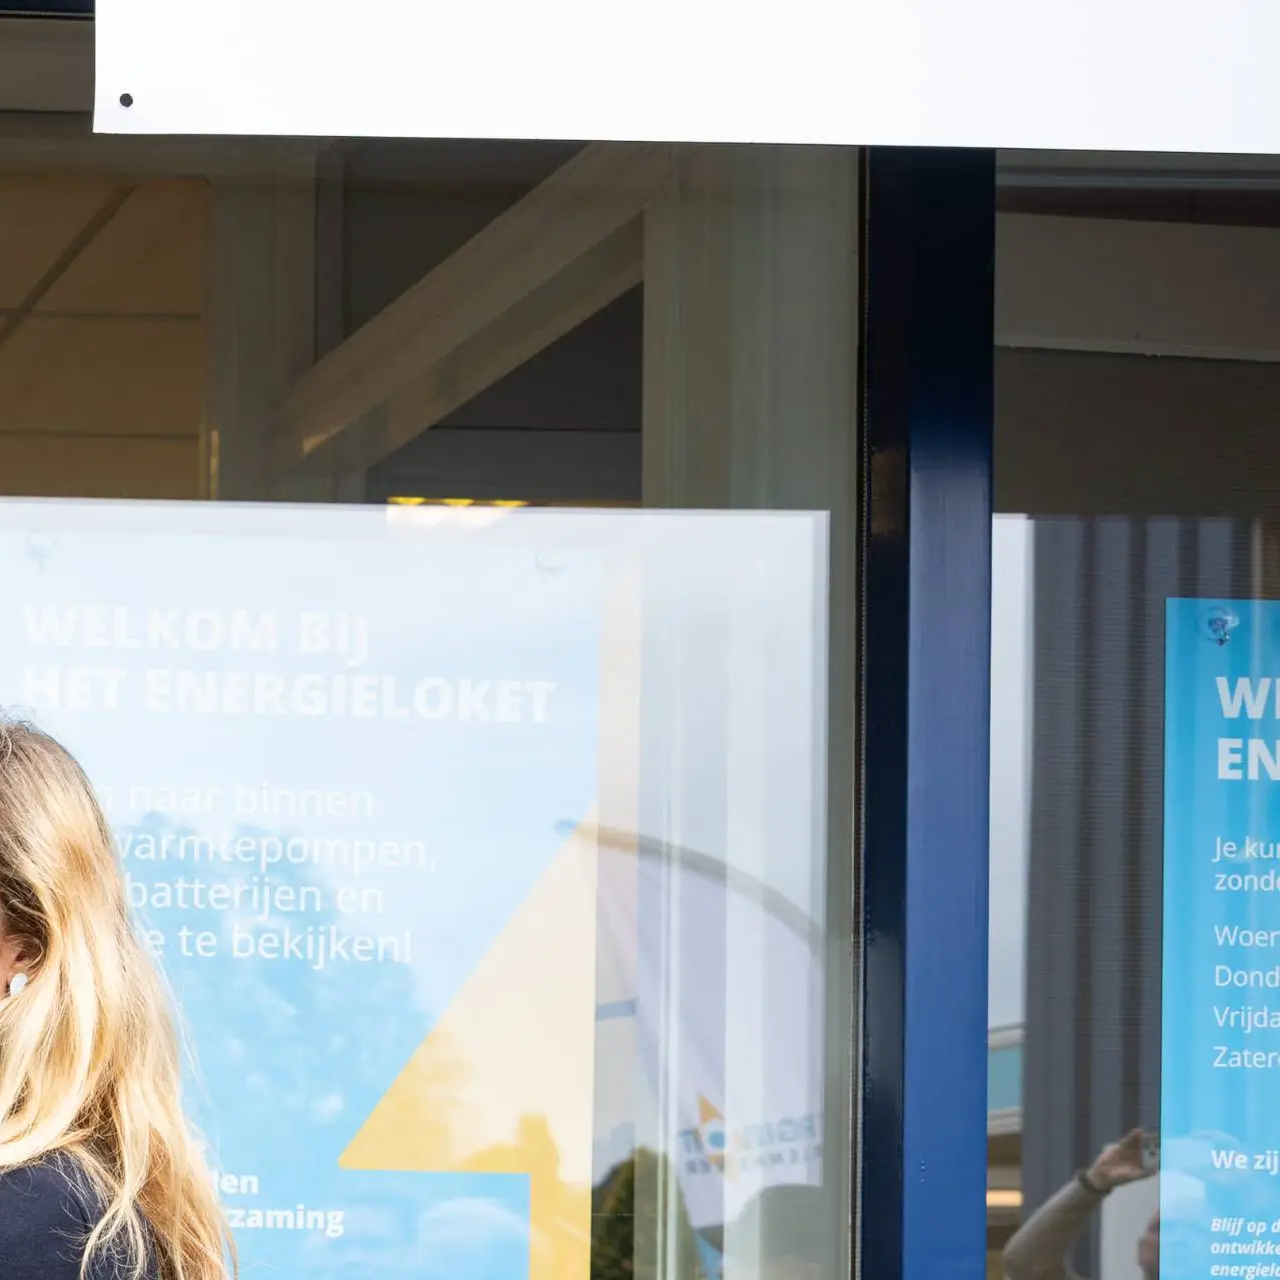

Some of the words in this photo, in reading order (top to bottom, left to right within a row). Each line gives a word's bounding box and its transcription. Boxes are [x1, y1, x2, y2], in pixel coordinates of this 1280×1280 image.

[21, 602, 278, 654] WELKOM
[298, 609, 371, 667] BIJ
[22, 665, 129, 712] HET
[144, 669, 559, 724] ENERGIELOKET
[1215, 676, 1280, 720] W
[129, 785, 223, 814] naar
[235, 780, 375, 818] binnen
[1211, 836, 1237, 862] Je
[1244, 836, 1280, 860] ku
[338, 884, 384, 914] en
[178, 925, 218, 958] te
[233, 923, 413, 970] bekijken!
[1215, 965, 1280, 988] Dond
[1213, 1005, 1280, 1034] Vrijda
[1213, 1046, 1280, 1069] Zater
[1211, 1150, 1248, 1170] We
[1210, 1217, 1245, 1236] Blijf
[1247, 1221, 1267, 1236] op
